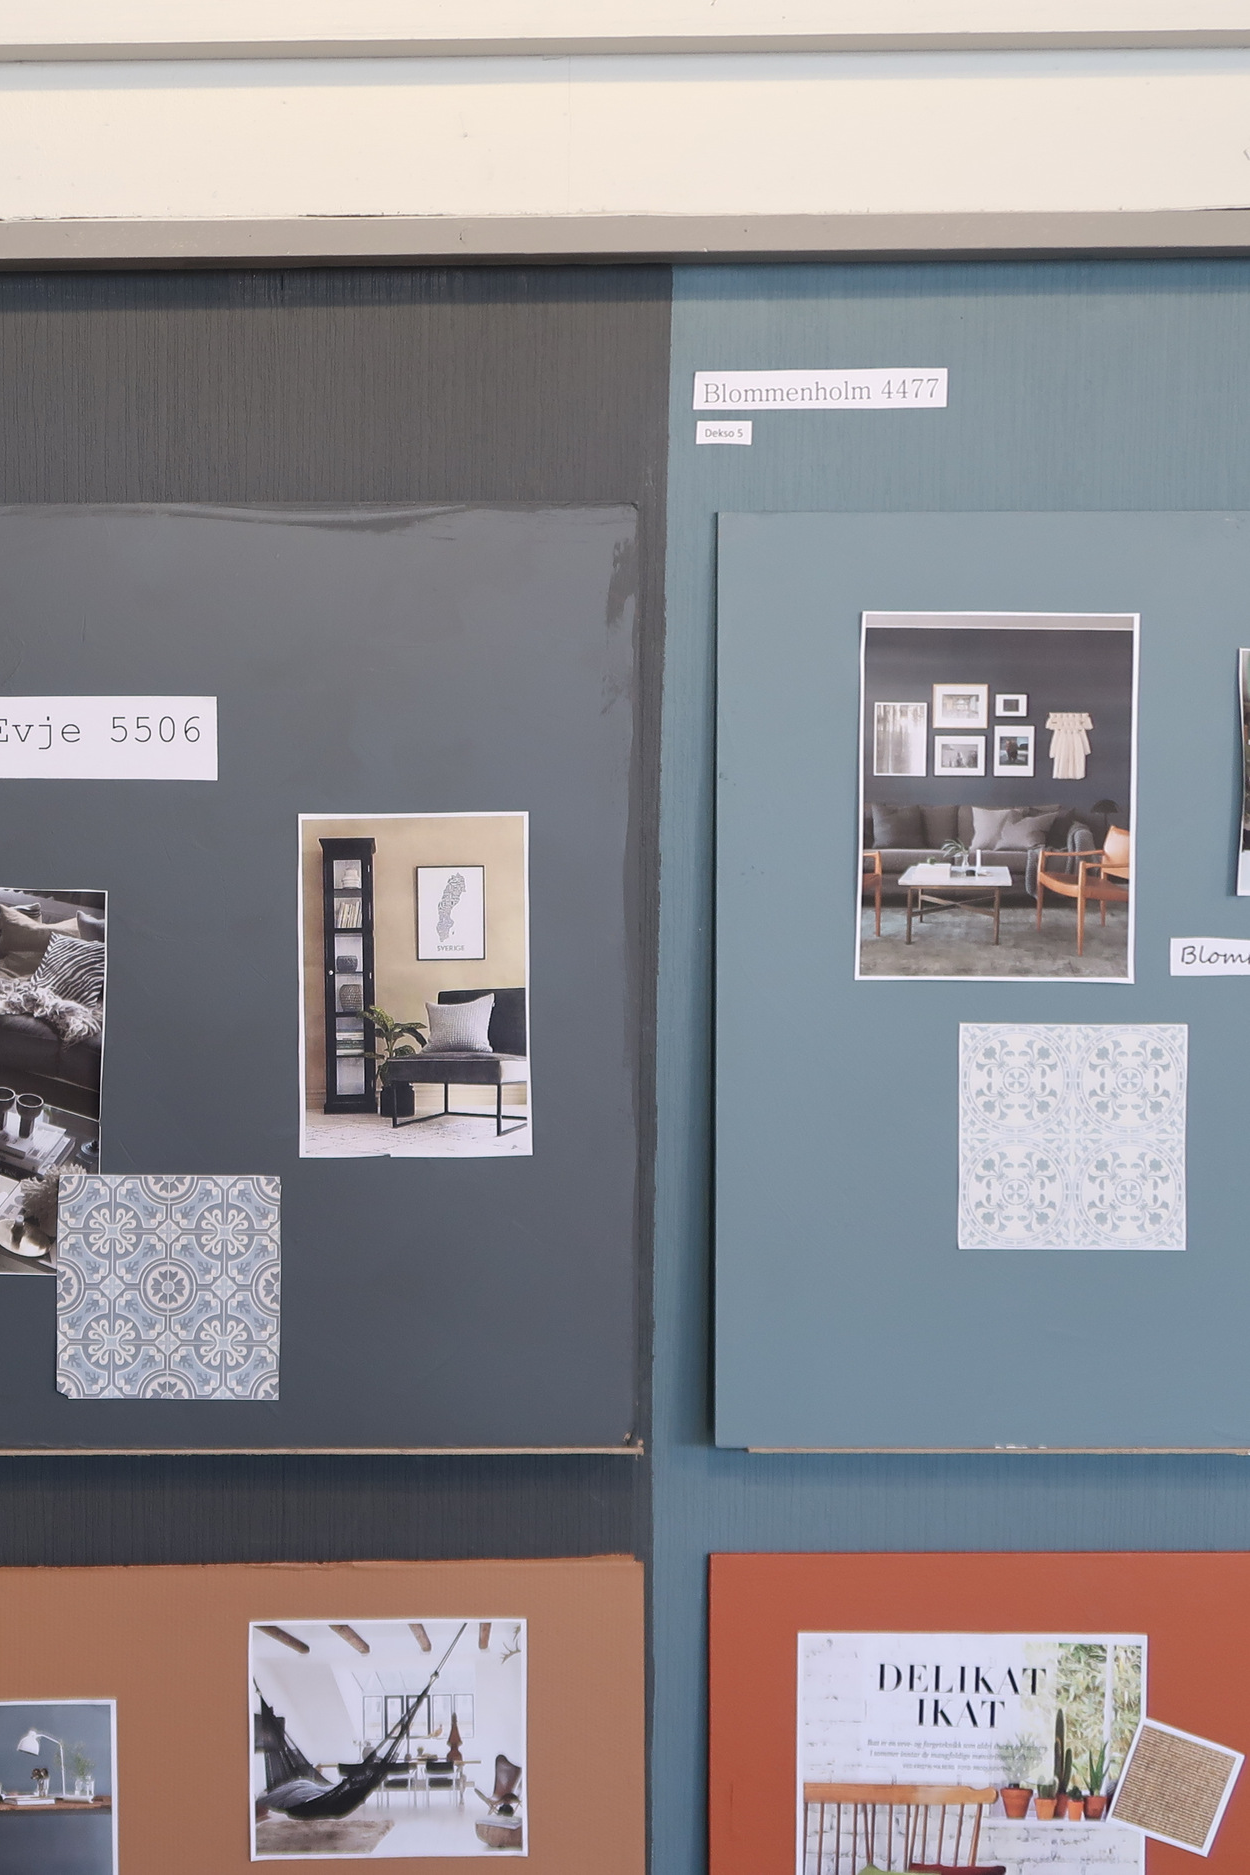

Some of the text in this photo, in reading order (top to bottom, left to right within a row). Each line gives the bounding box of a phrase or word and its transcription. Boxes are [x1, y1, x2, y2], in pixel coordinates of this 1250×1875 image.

[703, 378, 940, 404] Blommenholm 4477
[704, 428, 744, 438] Dekso 5
[110, 715, 201, 743] 5506
[877, 1663, 1047, 1696] DELIKAT
[916, 1698, 1006, 1728] IKAT
